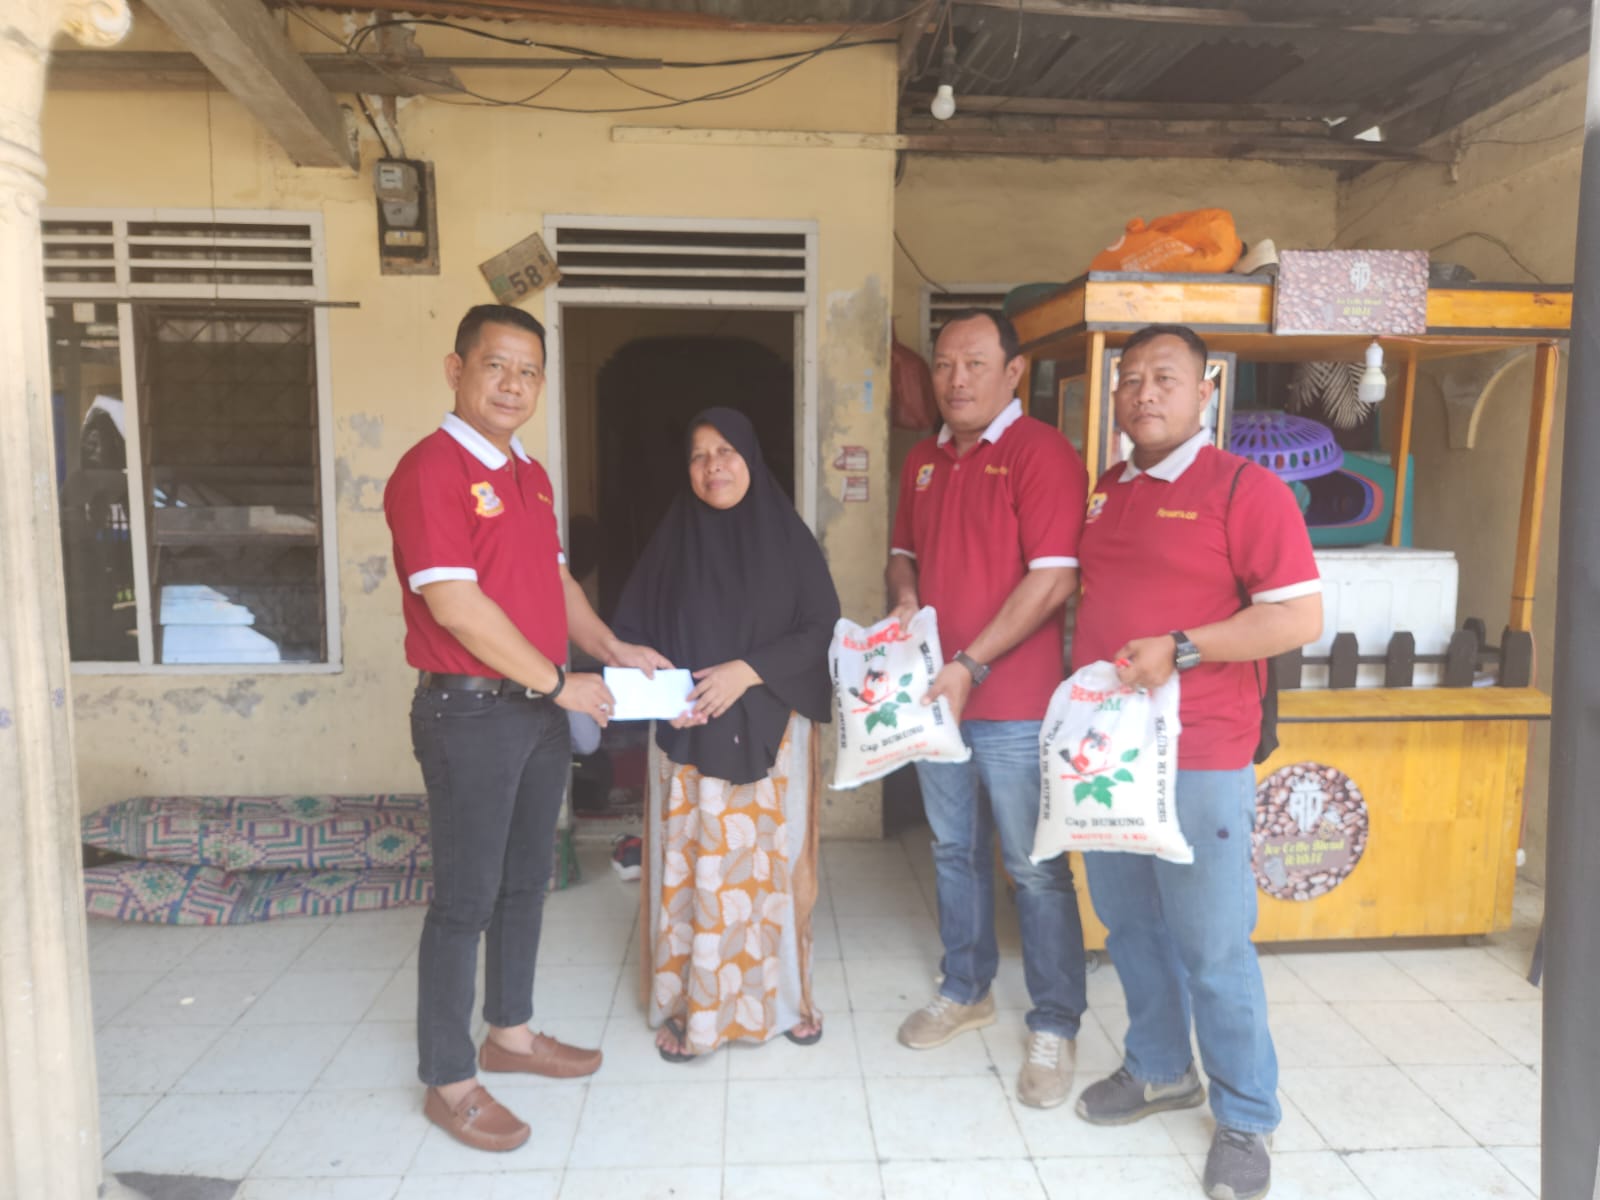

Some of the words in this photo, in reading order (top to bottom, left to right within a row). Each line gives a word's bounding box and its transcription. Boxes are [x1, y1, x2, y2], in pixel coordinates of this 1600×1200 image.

[508, 264, 543, 295] 58
[1155, 716, 1168, 756] SUPER
[1157, 779, 1168, 823] BERAS
[1065, 817, 1087, 828] Cap
[1091, 817, 1145, 827] BURUNG
